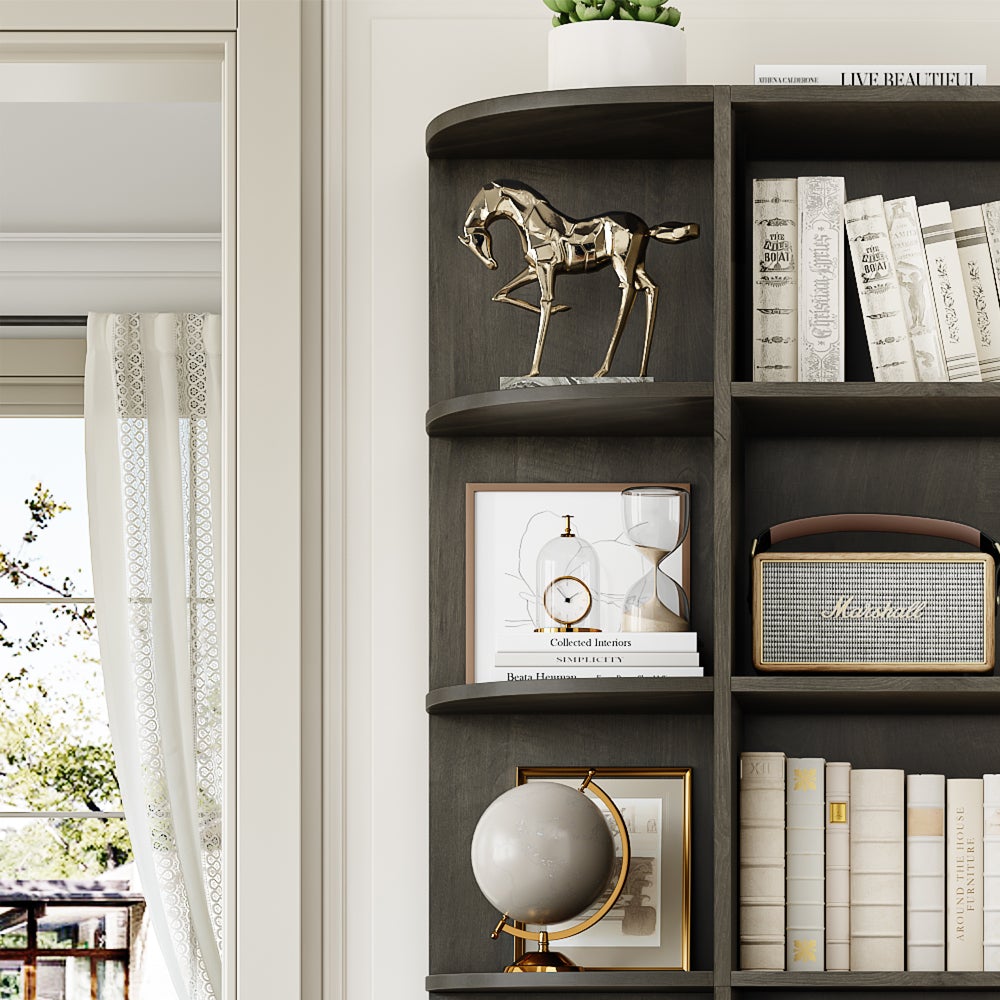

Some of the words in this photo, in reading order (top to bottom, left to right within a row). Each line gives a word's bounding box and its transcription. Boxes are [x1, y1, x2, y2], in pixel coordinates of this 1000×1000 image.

[841, 72, 878, 86] LIVE
[884, 72, 978, 86] BEAUTIFUL
[764, 251, 790, 262] BOAT
[821, 595, 927, 619] Marshall
[550, 638, 591, 647] Collected
[595, 638, 631, 647] Interiors
[507, 673, 532, 681] Beata
[956, 807, 965, 850] HOUSE
[956, 856, 965, 881] THE
[967, 837, 975, 911] FURNITURE
[956, 887, 965, 941] AROUND
